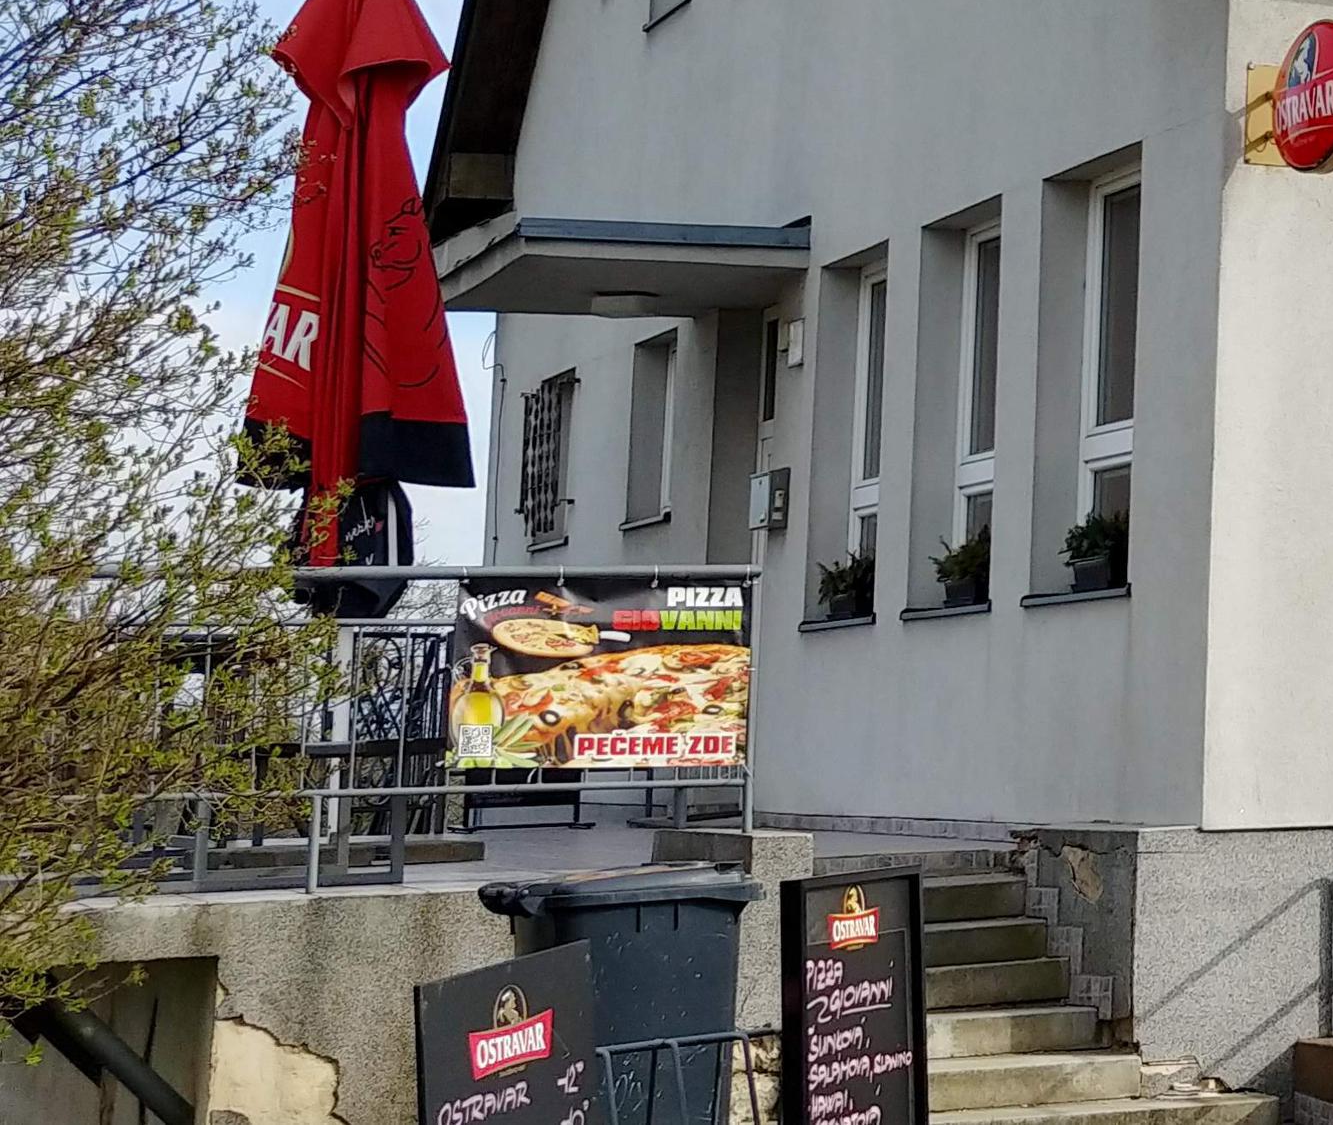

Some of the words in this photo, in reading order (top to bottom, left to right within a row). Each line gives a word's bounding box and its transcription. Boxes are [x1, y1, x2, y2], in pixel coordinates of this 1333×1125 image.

[262, 302, 320, 372] AR
[460, 589, 527, 620] Pizza
[667, 587, 744, 607] PIZZA
[613, 610, 742, 631] GIOVANNI
[577, 732, 679, 756] PEČEME
[688, 735, 734, 755] ZDE
[832, 914, 876, 942] OSTRAVAR
[806, 959, 843, 994] PIZZA
[476, 1022, 546, 1069] OSTRAVAR
[437, 1080, 530, 1125] OSTRAVAR
